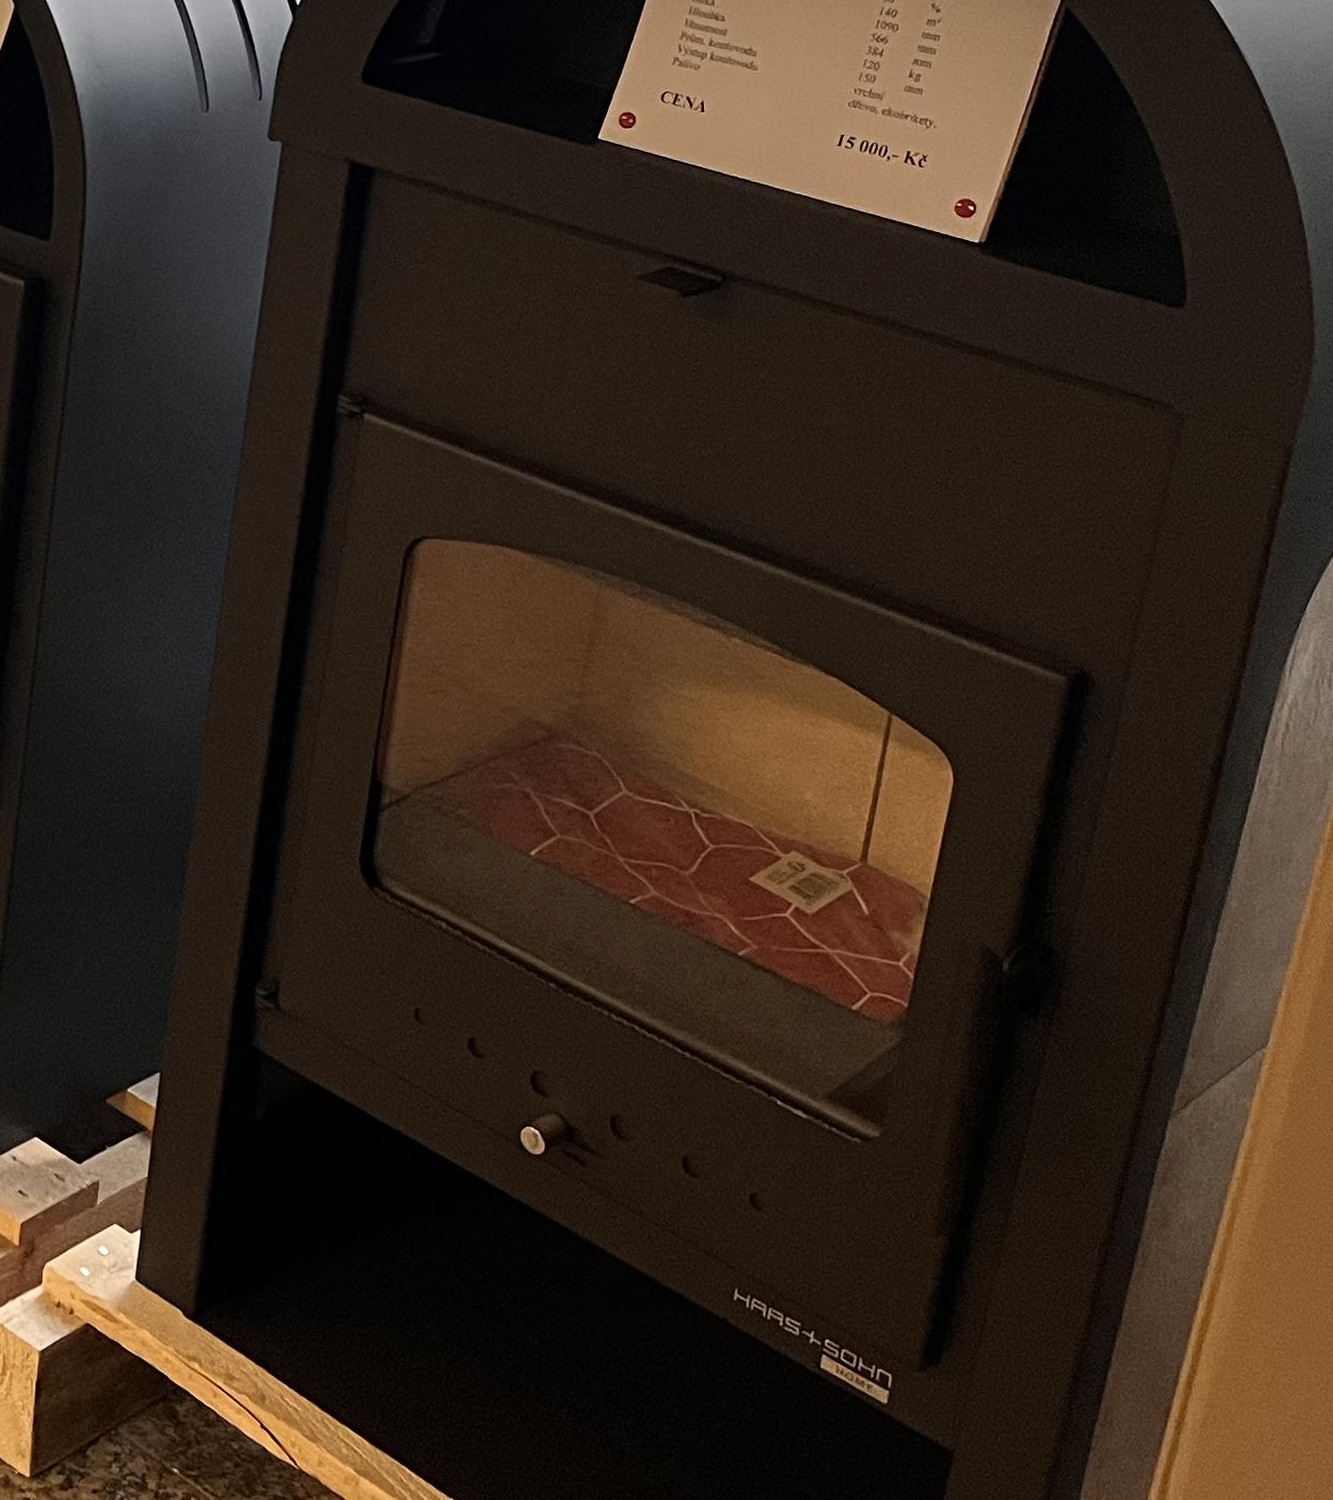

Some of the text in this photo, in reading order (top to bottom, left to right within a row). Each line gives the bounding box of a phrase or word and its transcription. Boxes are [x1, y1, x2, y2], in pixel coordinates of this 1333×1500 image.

[879, 6, 898, 18] 140
[875, 19, 899, 32] 1090
[862, 59, 881, 71] 120
[908, 70, 922, 83] kg
[858, 72, 877, 84] 150
[660, 90, 929, 168] CENA 15 000,- Kč
